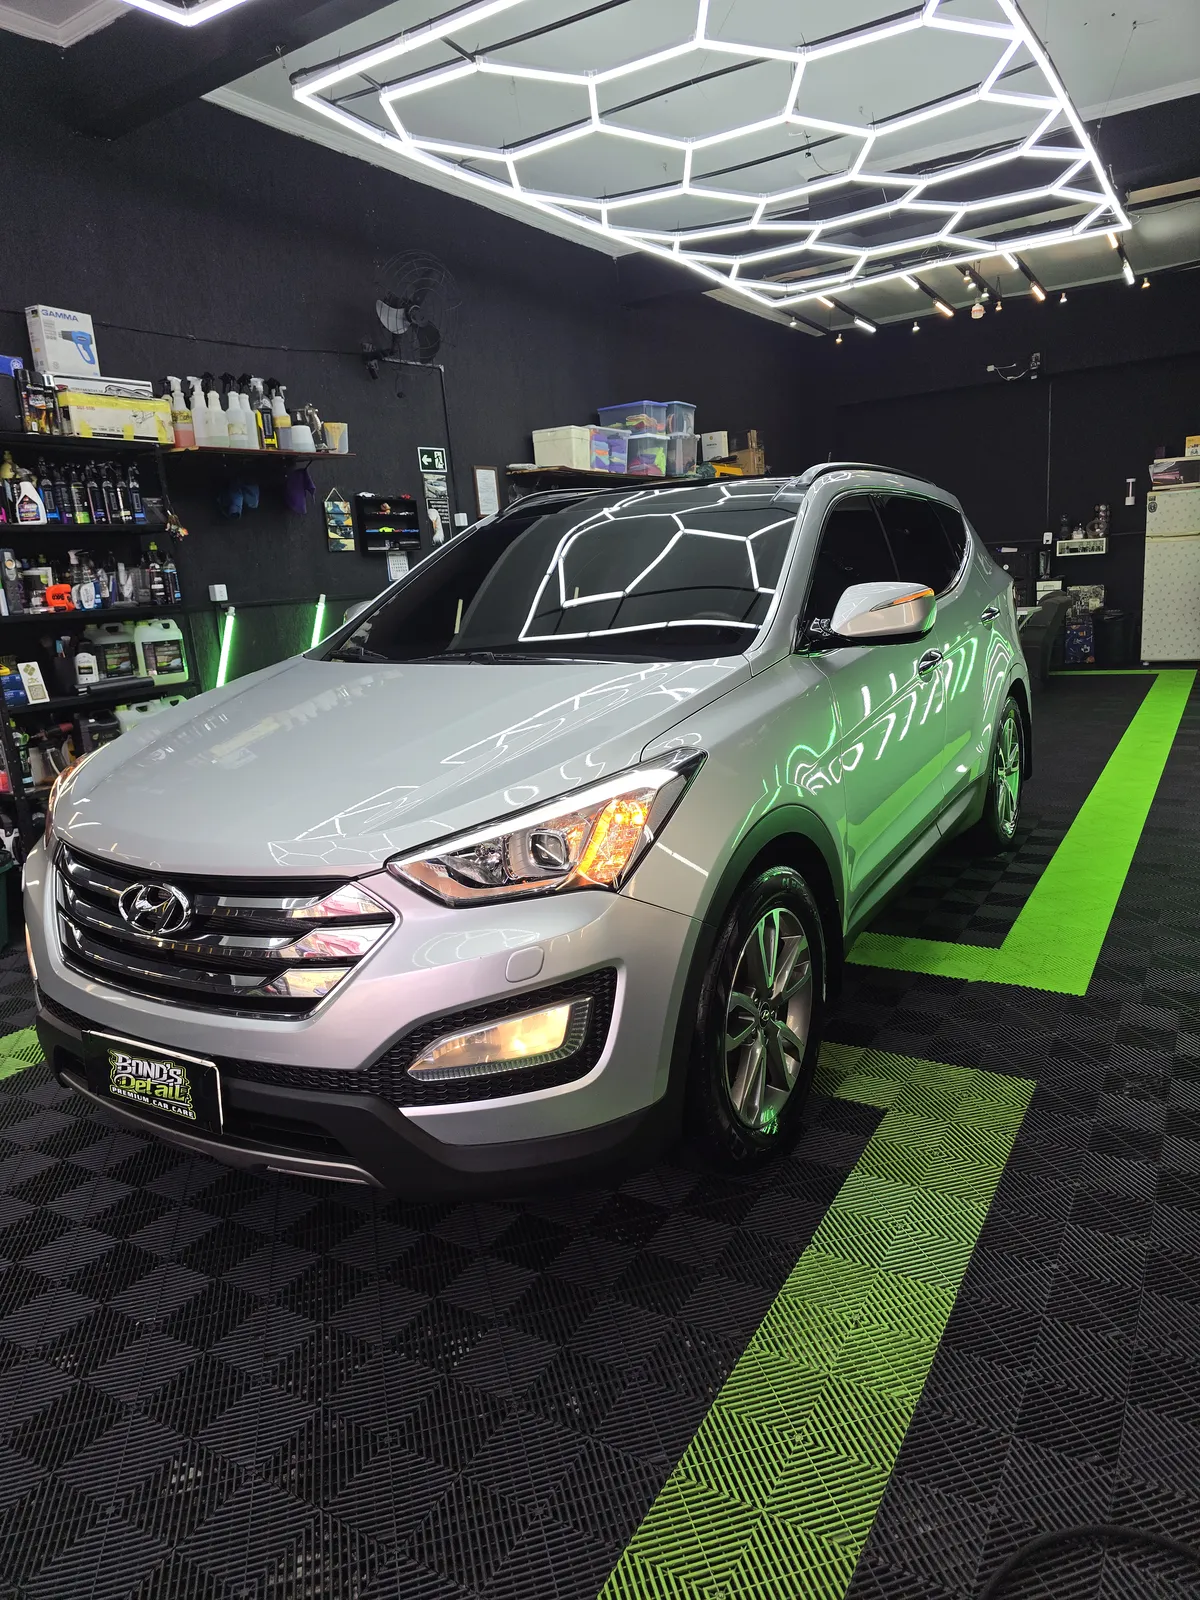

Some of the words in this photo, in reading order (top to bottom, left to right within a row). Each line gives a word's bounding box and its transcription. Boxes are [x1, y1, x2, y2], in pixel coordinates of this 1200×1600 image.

[41, 309, 79, 322] GAMMA
[114, 1052, 182, 1085] BOND'S
[112, 1086, 150, 1103] PREMIUM
[152, 1098, 169, 1110] CAR
[172, 1106, 194, 1118] CARE
